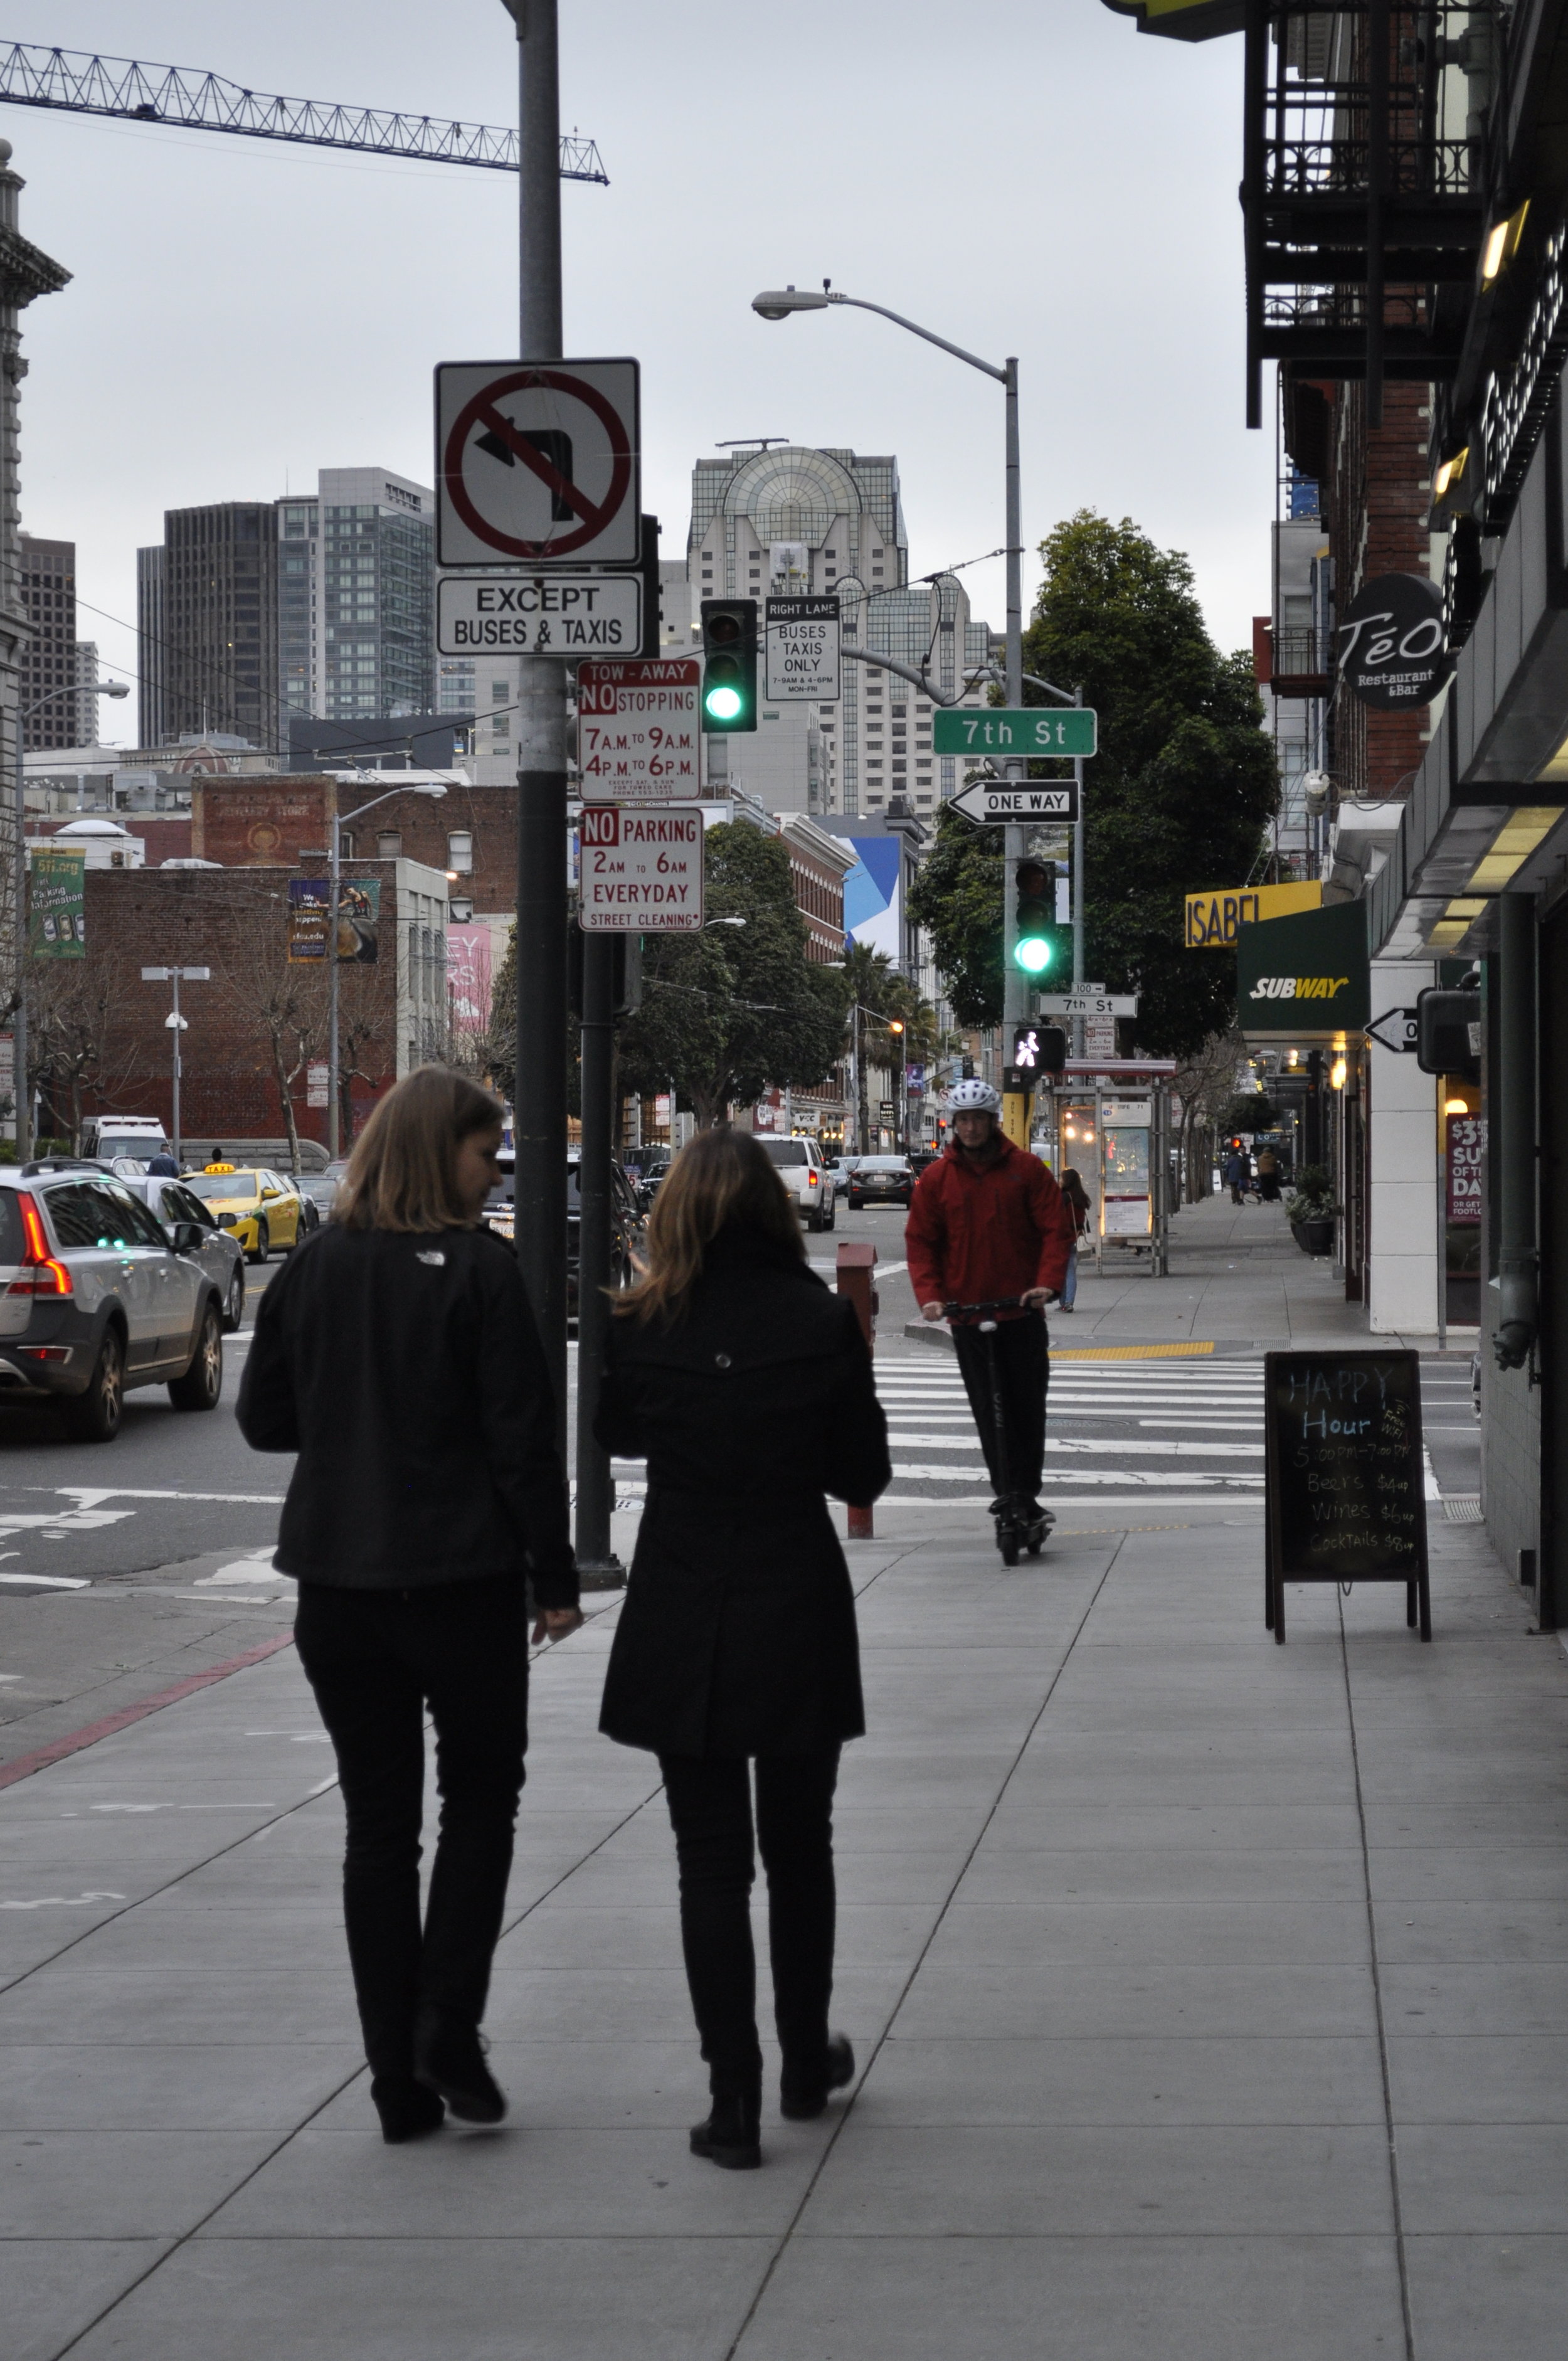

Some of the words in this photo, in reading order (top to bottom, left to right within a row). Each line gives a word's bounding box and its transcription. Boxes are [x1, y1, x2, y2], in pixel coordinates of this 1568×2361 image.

[477, 587, 600, 612] EXCEPT
[770, 604, 802, 615] RIGHT
[806, 603, 836, 614] LANE
[454, 618, 527, 645] BUSES
[538, 619, 552, 645] &
[562, 618, 623, 645] TAXIS
[779, 625, 827, 639] BUSES
[783, 642, 823, 655] TAXIS
[591, 666, 624, 681] TOW
[640, 664, 688, 679] AWAY
[785, 659, 820, 672] ONLY
[1358, 669, 1435, 686] Restaurant
[581, 684, 615, 711] NO
[618, 691, 694, 712] STOPPING
[632, 733, 645, 744] TO
[962, 720, 1012, 745] 7th
[1035, 721, 1066, 745] St
[632, 760, 645, 770] TO
[988, 794, 1024, 810] ONE
[1029, 794, 1065, 809] WAY
[585, 812, 614, 842] NO
[623, 819, 696, 842] PARKING
[636, 865, 646, 873] TO
[32, 886, 66, 899] Paking
[593, 884, 689, 903] EVERYDAY
[31, 893, 83, 910] Information
[591, 914, 632, 926] STREET
[638, 914, 692, 926] CLEANING
[1076, 984, 1091, 993] 100
[1249, 977, 1350, 1000] SUBWAY
[1062, 999, 1086, 1012] 7th
[1096, 1000, 1113, 1012] St
[1453, 1147, 1481, 1165] SU
[1453, 1167, 1469, 1177] OF
[1453, 1178, 1481, 1196] DA
[1289, 1366, 1394, 1410] HAPPY
[1303, 1408, 1371, 1440] Hour
[1383, 1409, 1406, 1428] Free
[1308, 1473, 1365, 1492] Beers
[1311, 1500, 1371, 1521] Wines
